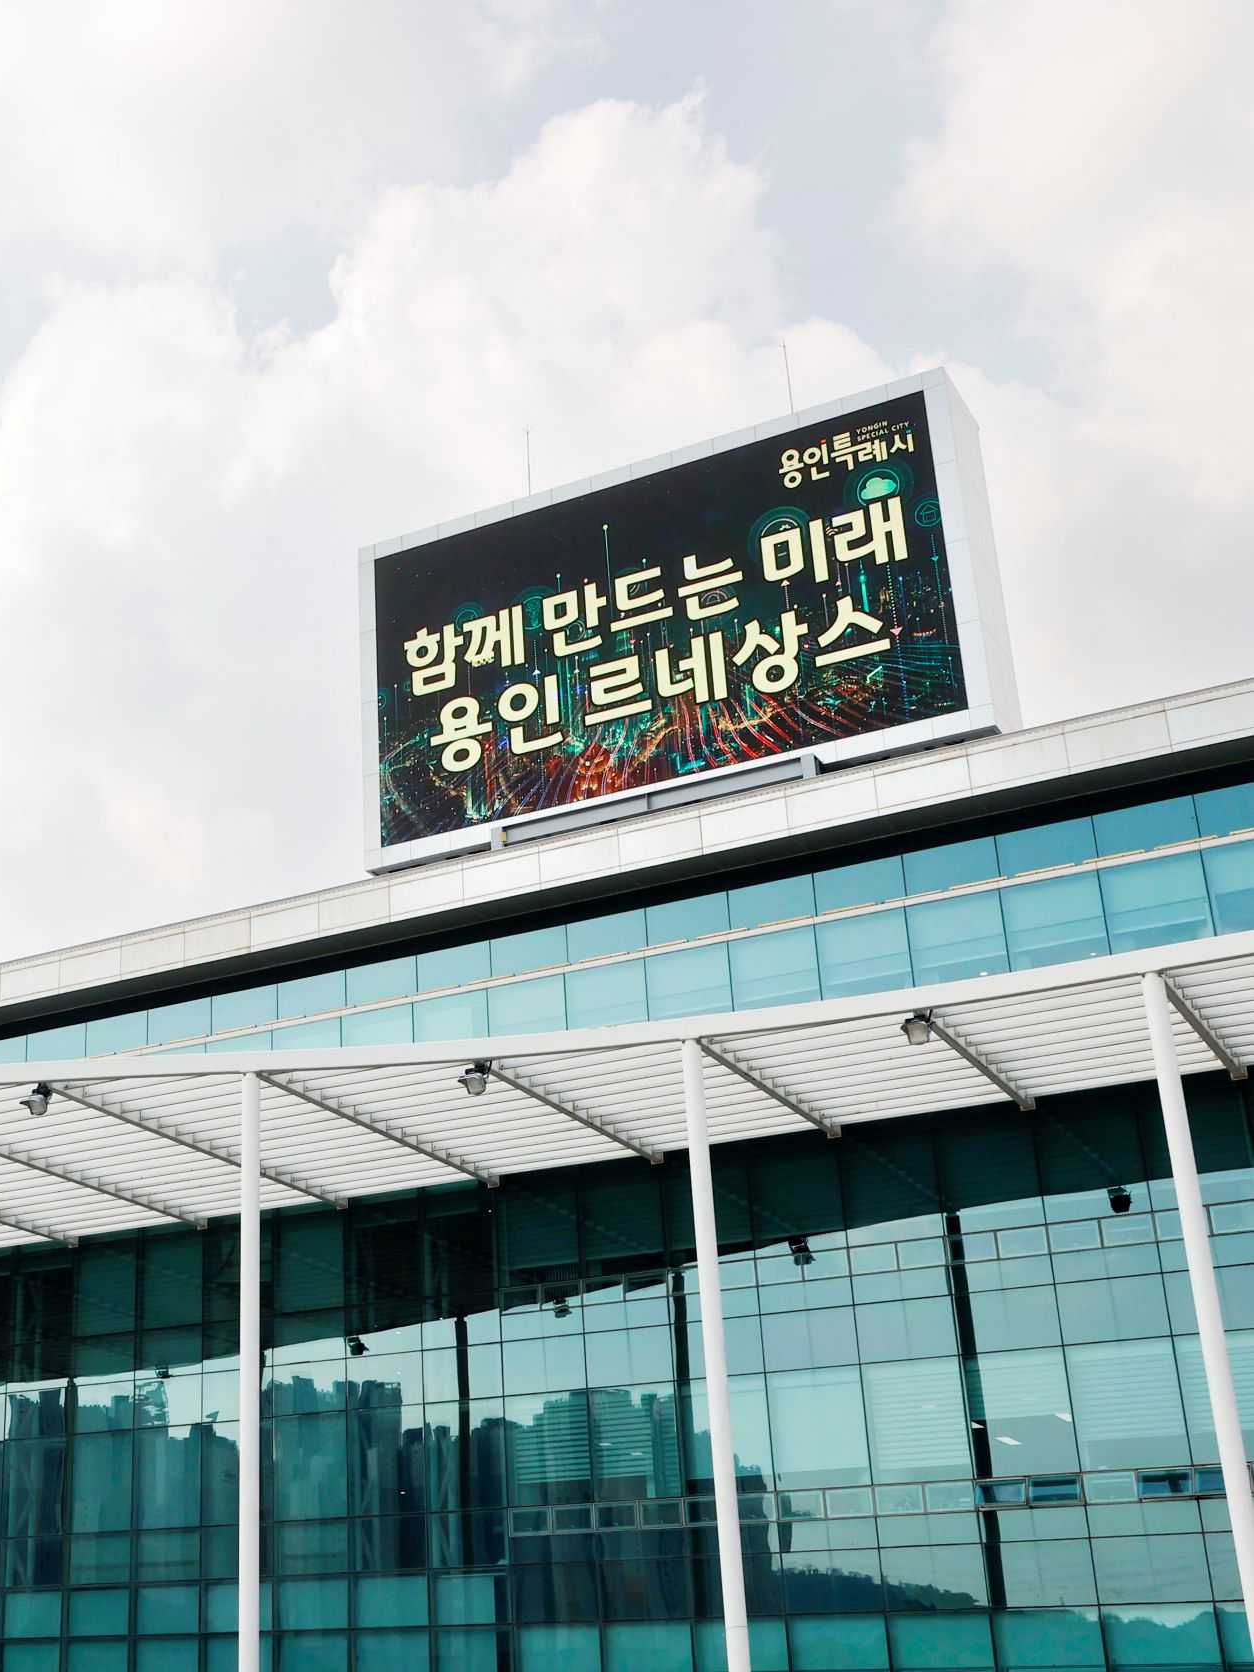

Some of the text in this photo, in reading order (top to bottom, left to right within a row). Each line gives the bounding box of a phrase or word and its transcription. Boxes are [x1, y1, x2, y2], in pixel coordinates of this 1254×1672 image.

[856, 420, 888, 434] YONGIN
[857, 421, 910, 442] SPECIAL CITY
[779, 430, 914, 488] 용인특례시
[404, 497, 908, 696] 함께 만드는 미래
[431, 596, 891, 772] 용인 르네상스
